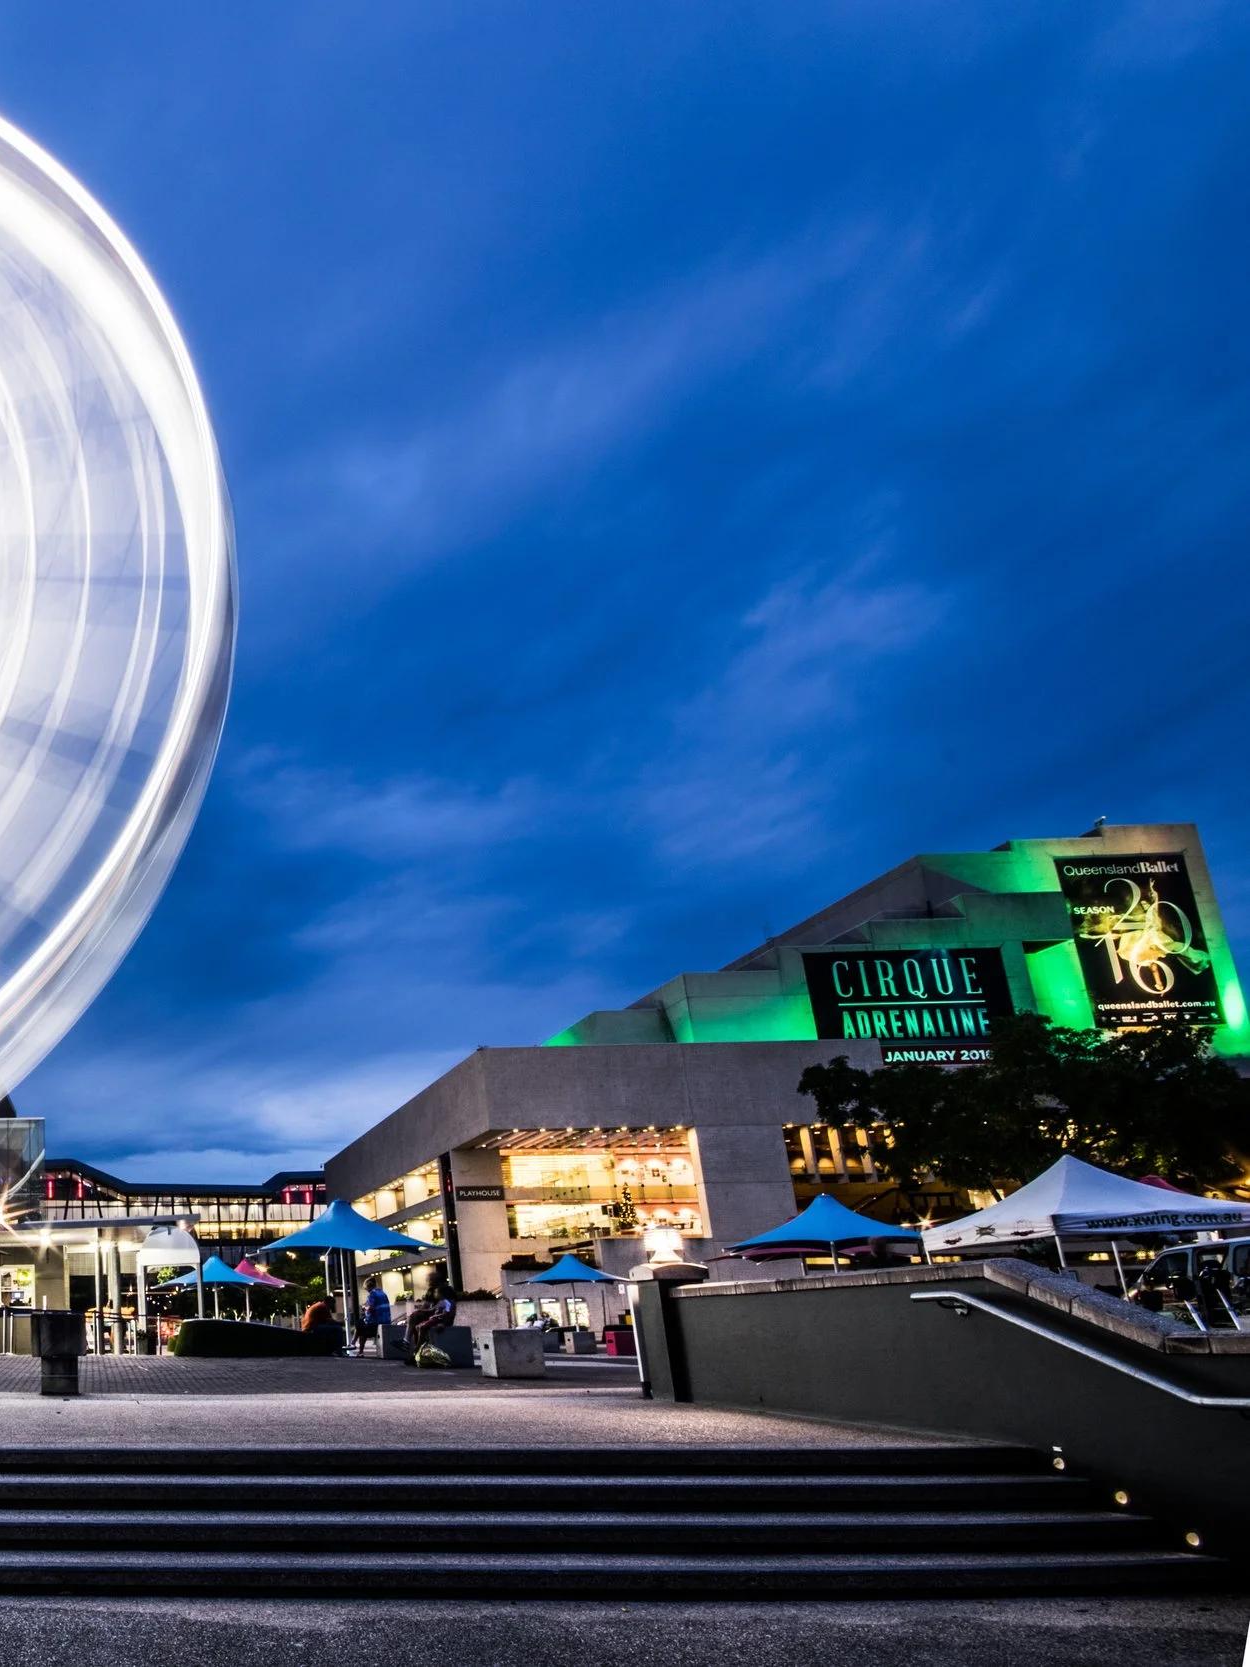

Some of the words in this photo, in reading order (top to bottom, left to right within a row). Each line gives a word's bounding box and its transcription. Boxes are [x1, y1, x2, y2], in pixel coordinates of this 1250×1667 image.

[1063, 861, 1180, 876] QueenslandBallet
[1073, 906, 1115, 915] SEASON
[831, 957, 983, 998] CIRQUE
[1097, 1000, 1216, 1011] queenslandballet.com.au
[842, 1008, 992, 1039] ADRENALINE
[885, 1050, 957, 1062] JANUARY
[1085, 1211, 1243, 1229] www.xwing.com.au
